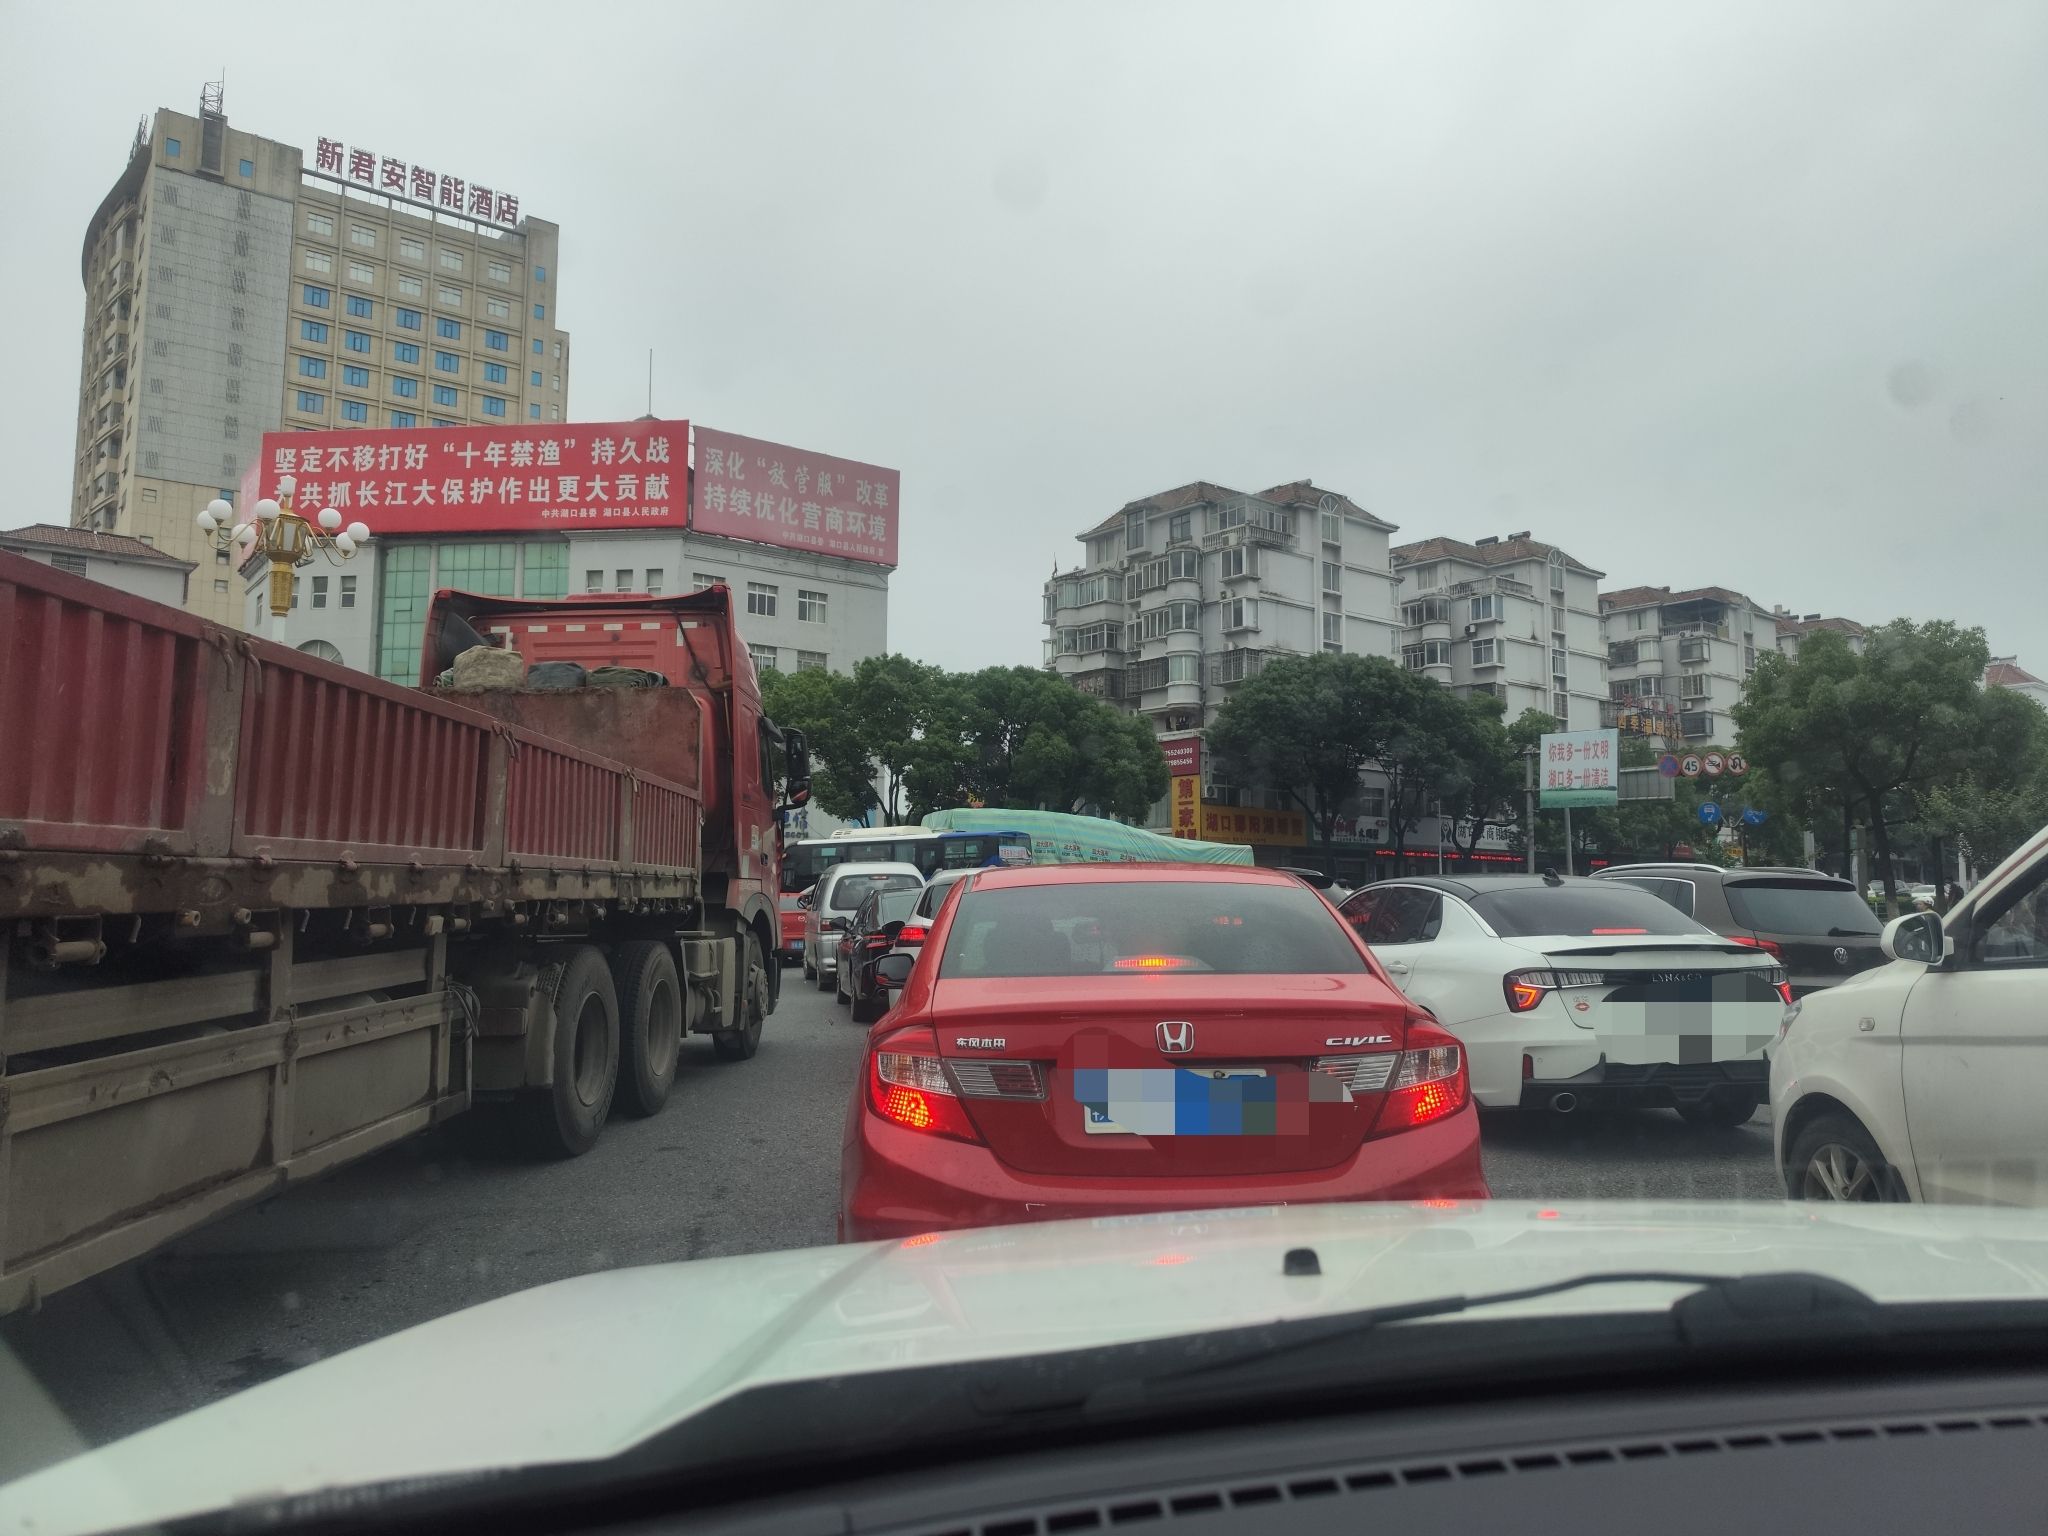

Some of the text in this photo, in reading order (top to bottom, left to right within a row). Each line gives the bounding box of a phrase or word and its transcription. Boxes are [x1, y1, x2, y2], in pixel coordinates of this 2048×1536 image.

[316, 136, 519, 226] 新君安智能酒店
[541, 506, 669, 518] 中共湖口县委 湖口县人民政府
[704, 481, 887, 542] 持续优化营商环境
[1548, 740, 1609, 762] 你我多一份文明
[1684, 761, 1698, 773] 45
[1548, 768, 1609, 788] 湖口多一份清洁
[1178, 778, 1194, 828] 第一家
[956, 1037, 1006, 1048] 东风本田
[1325, 1035, 1393, 1046] CIVIC
